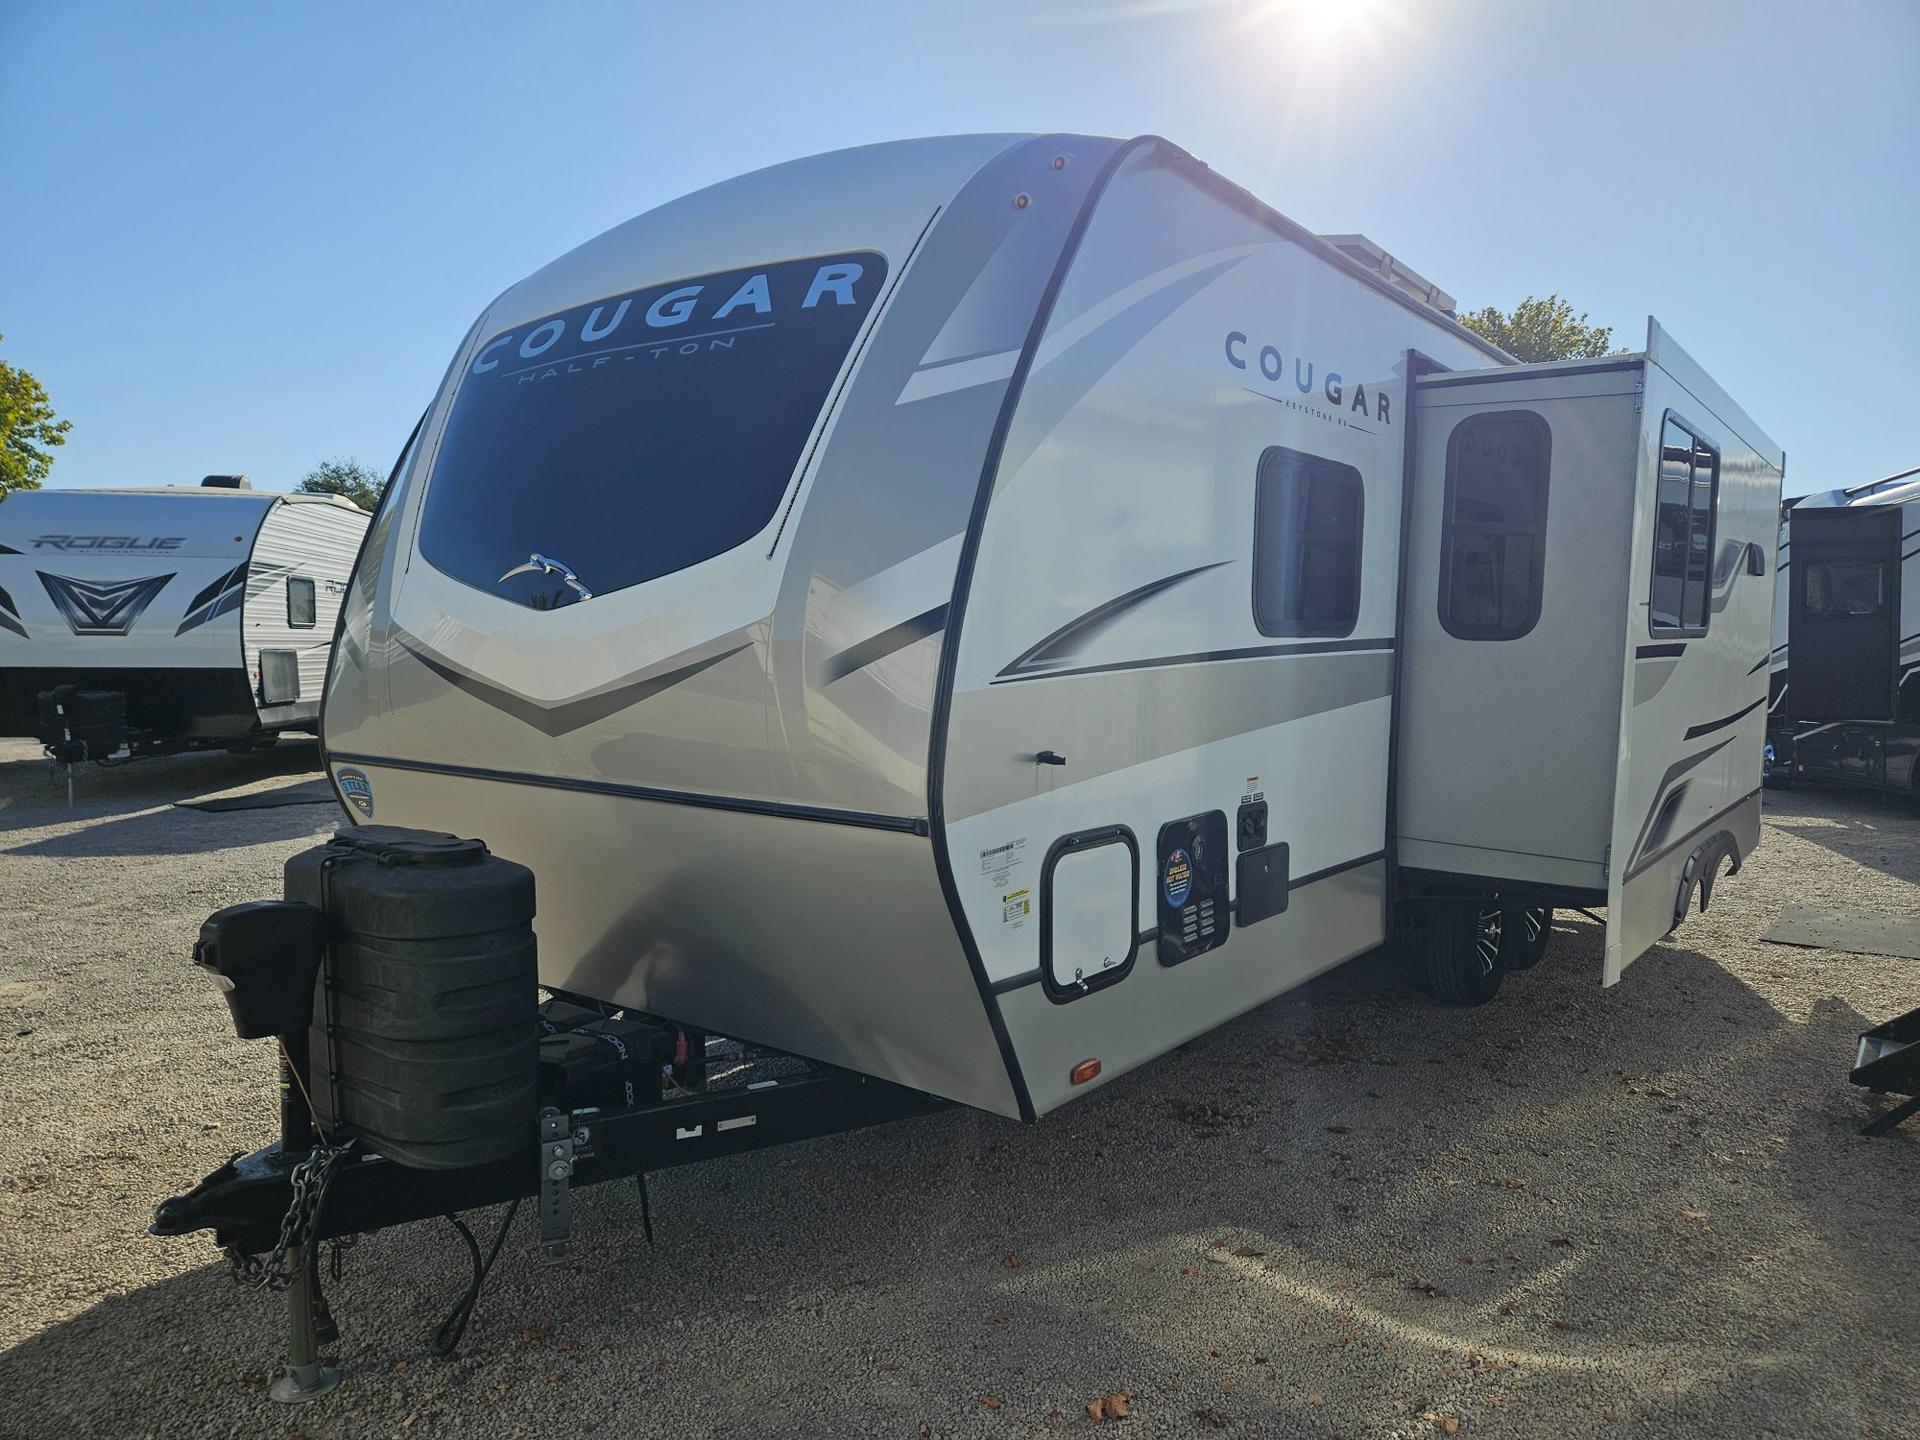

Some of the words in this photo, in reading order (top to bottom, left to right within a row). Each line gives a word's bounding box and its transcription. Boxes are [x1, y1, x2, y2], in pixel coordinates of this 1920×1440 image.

[472, 263, 863, 375] COUGAR
[517, 337, 735, 385] HALF-TON
[1225, 331, 1391, 425] COUGAR
[29, 534, 188, 551] ROGUE
